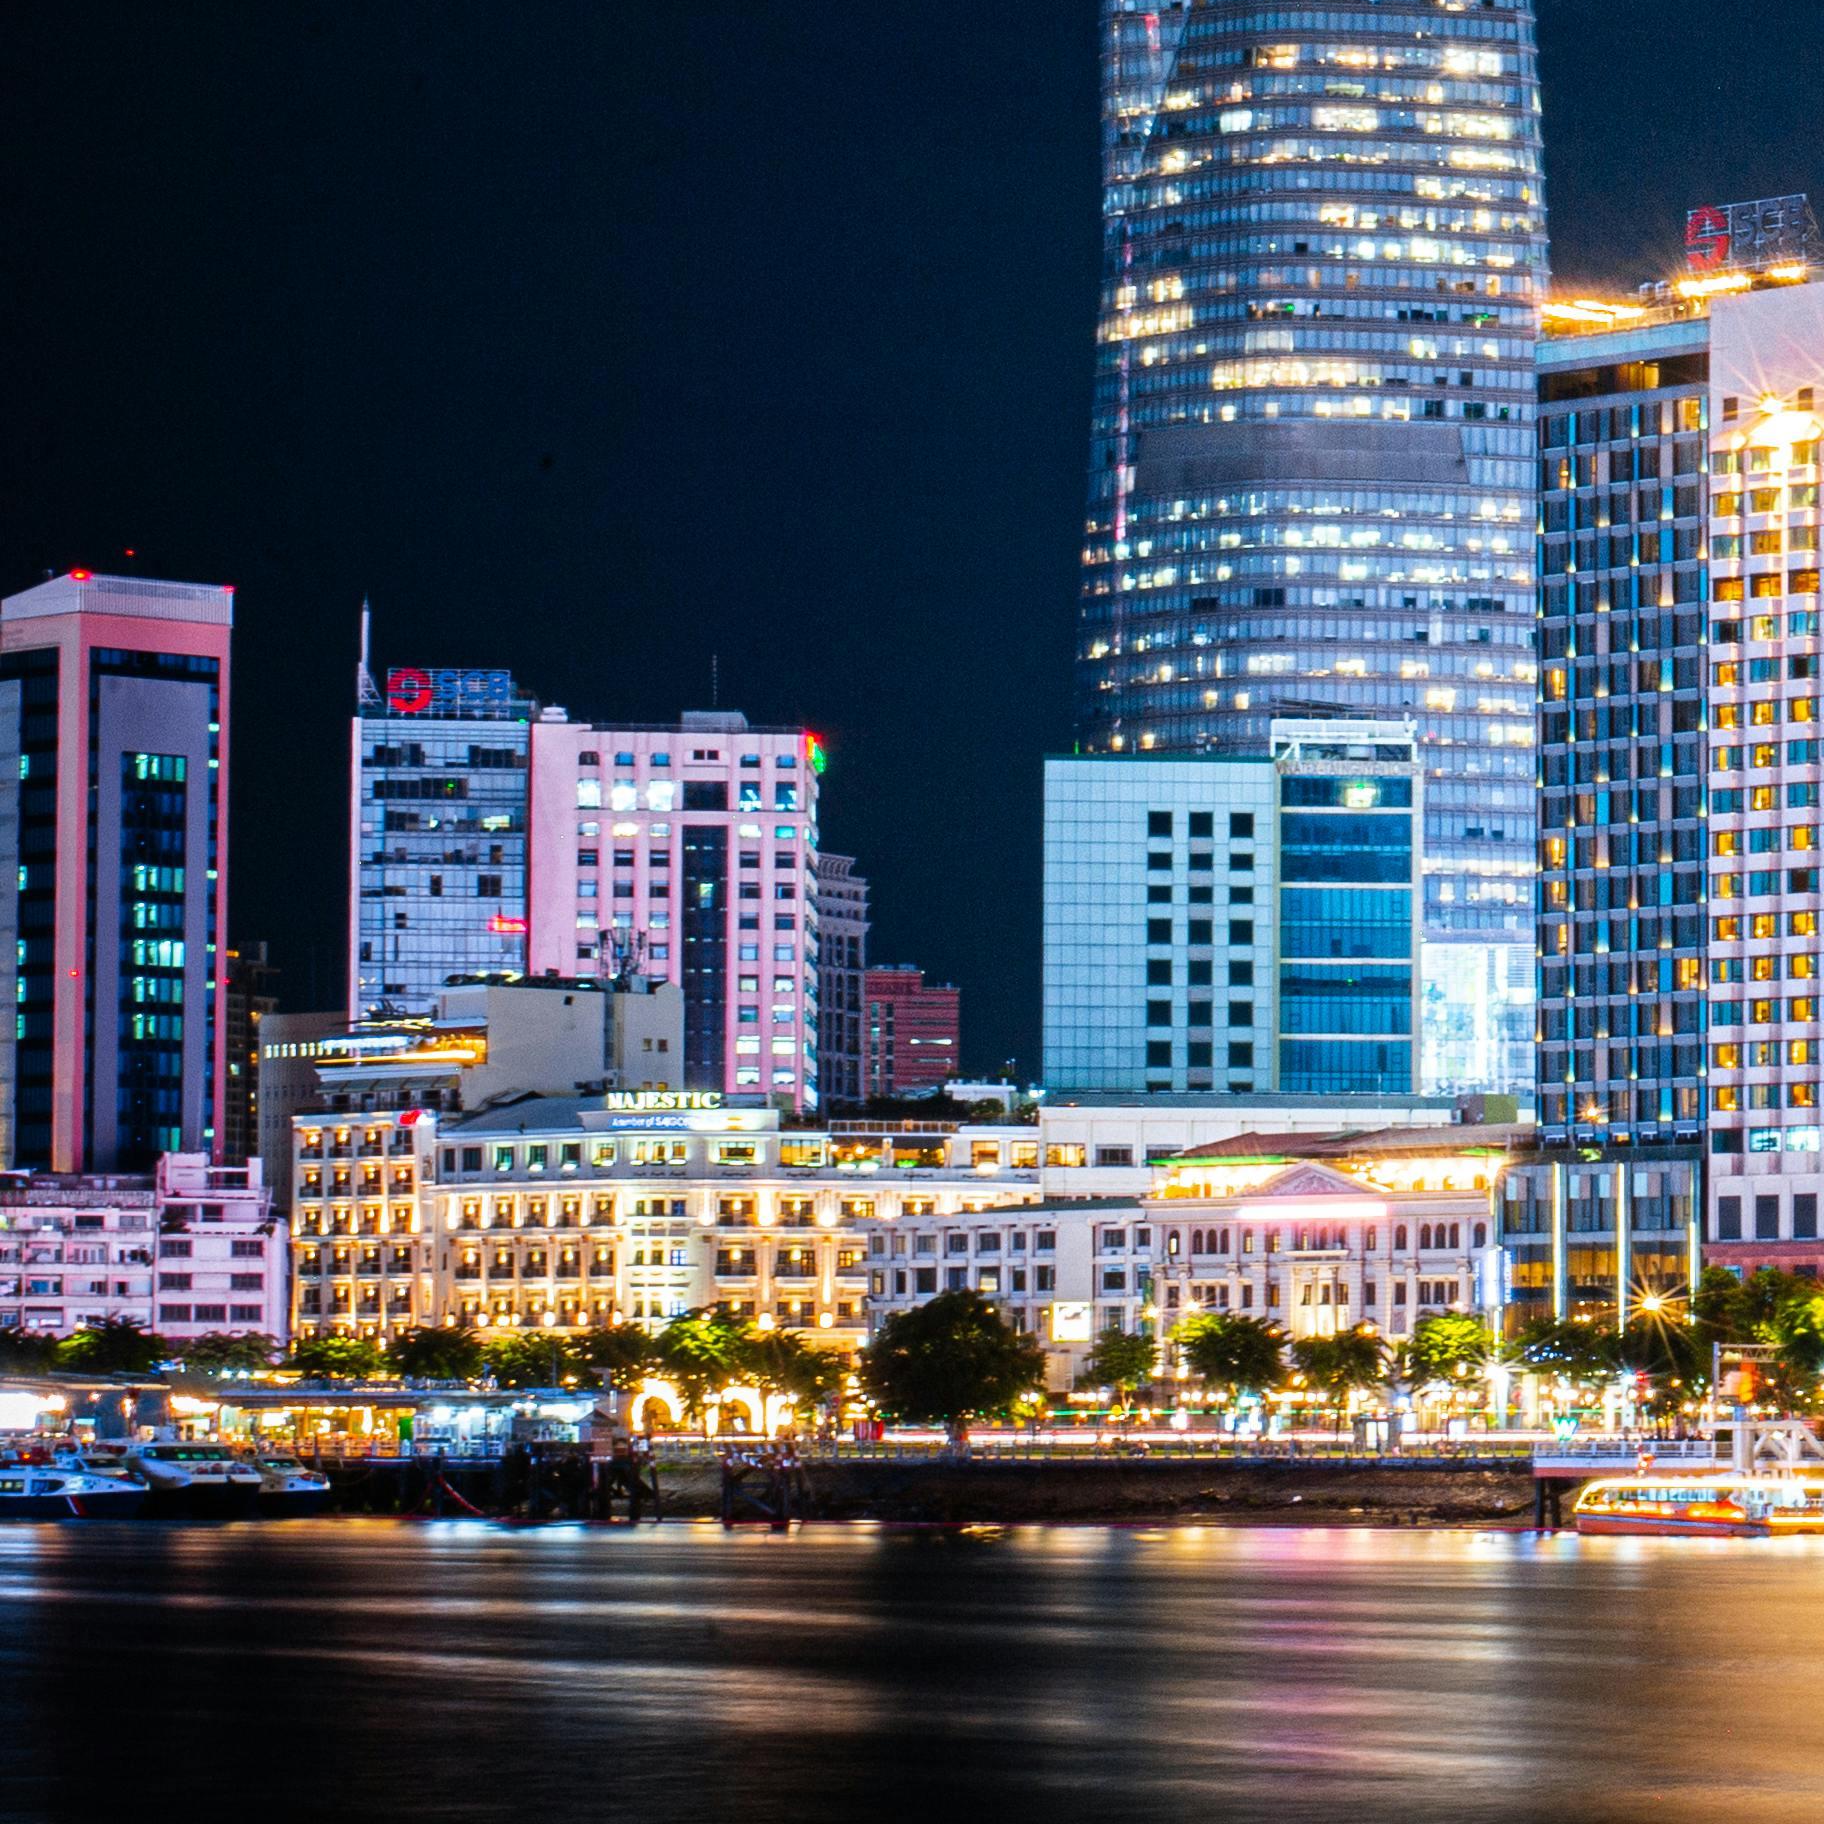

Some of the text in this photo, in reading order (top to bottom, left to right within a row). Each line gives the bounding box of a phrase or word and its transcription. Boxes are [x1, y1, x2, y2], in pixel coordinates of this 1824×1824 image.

[1732, 198, 1806, 250] SCB
[438, 671, 508, 700] SCB
[607, 1091, 721, 1109] MAJESTIC
